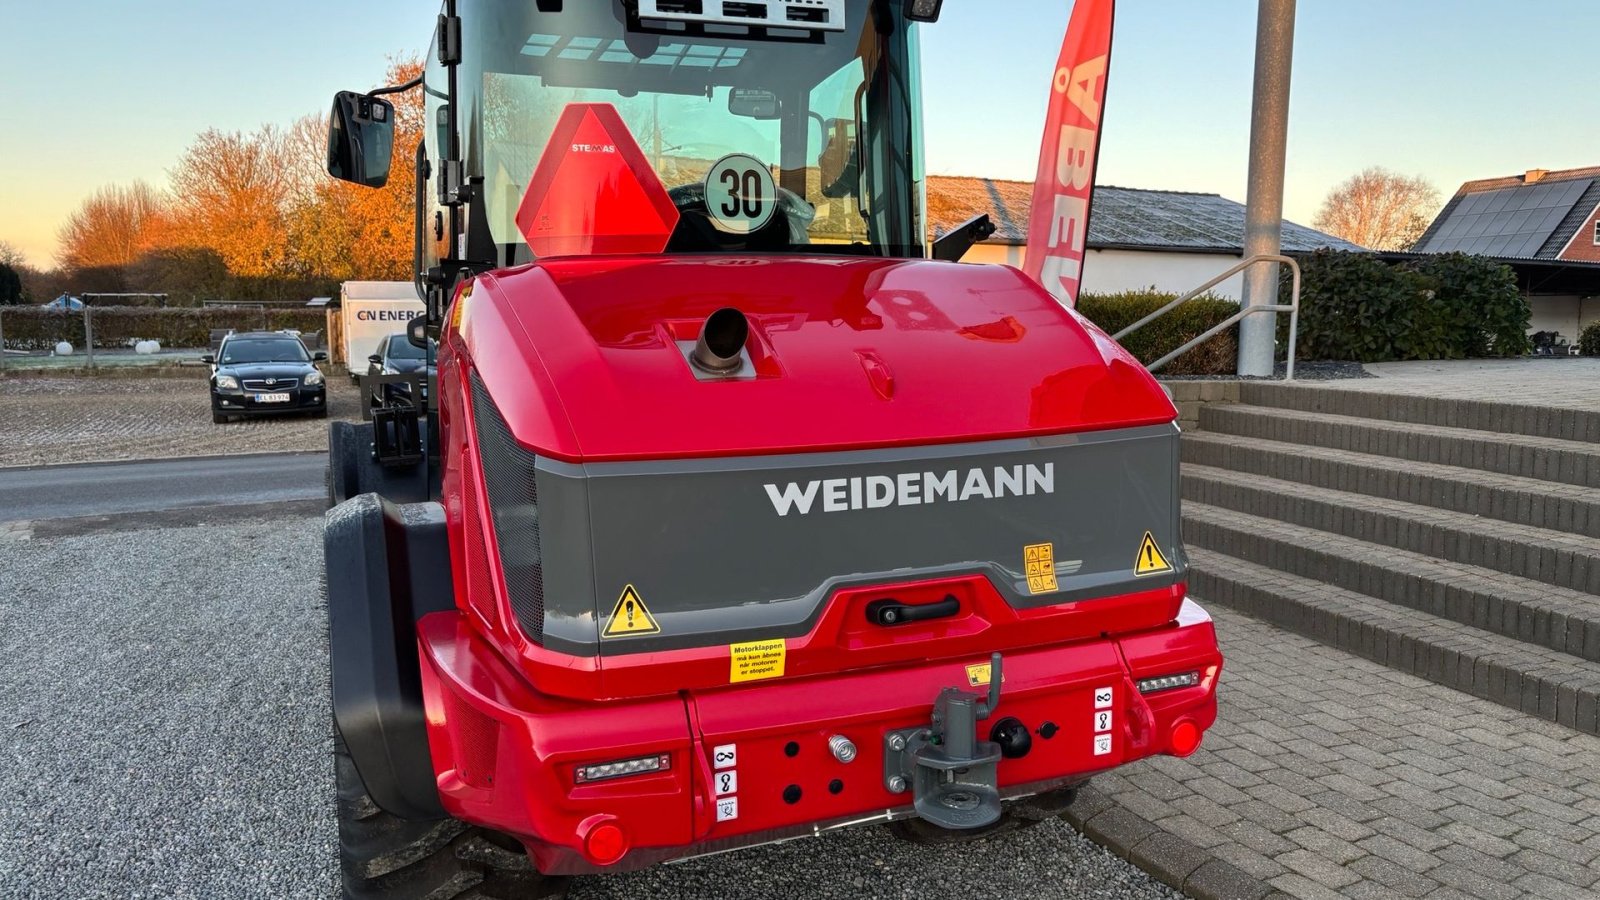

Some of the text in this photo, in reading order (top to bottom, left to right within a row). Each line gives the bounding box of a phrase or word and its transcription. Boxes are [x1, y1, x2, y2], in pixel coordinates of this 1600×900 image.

[572, 144, 615, 153] STEMAS
[720, 168, 762, 219] 30
[357, 310, 376, 321] CN
[763, 462, 1054, 516] WEIDEMANN
[734, 643, 783, 653] Motorklappen
[751, 659, 778, 667] motoren
